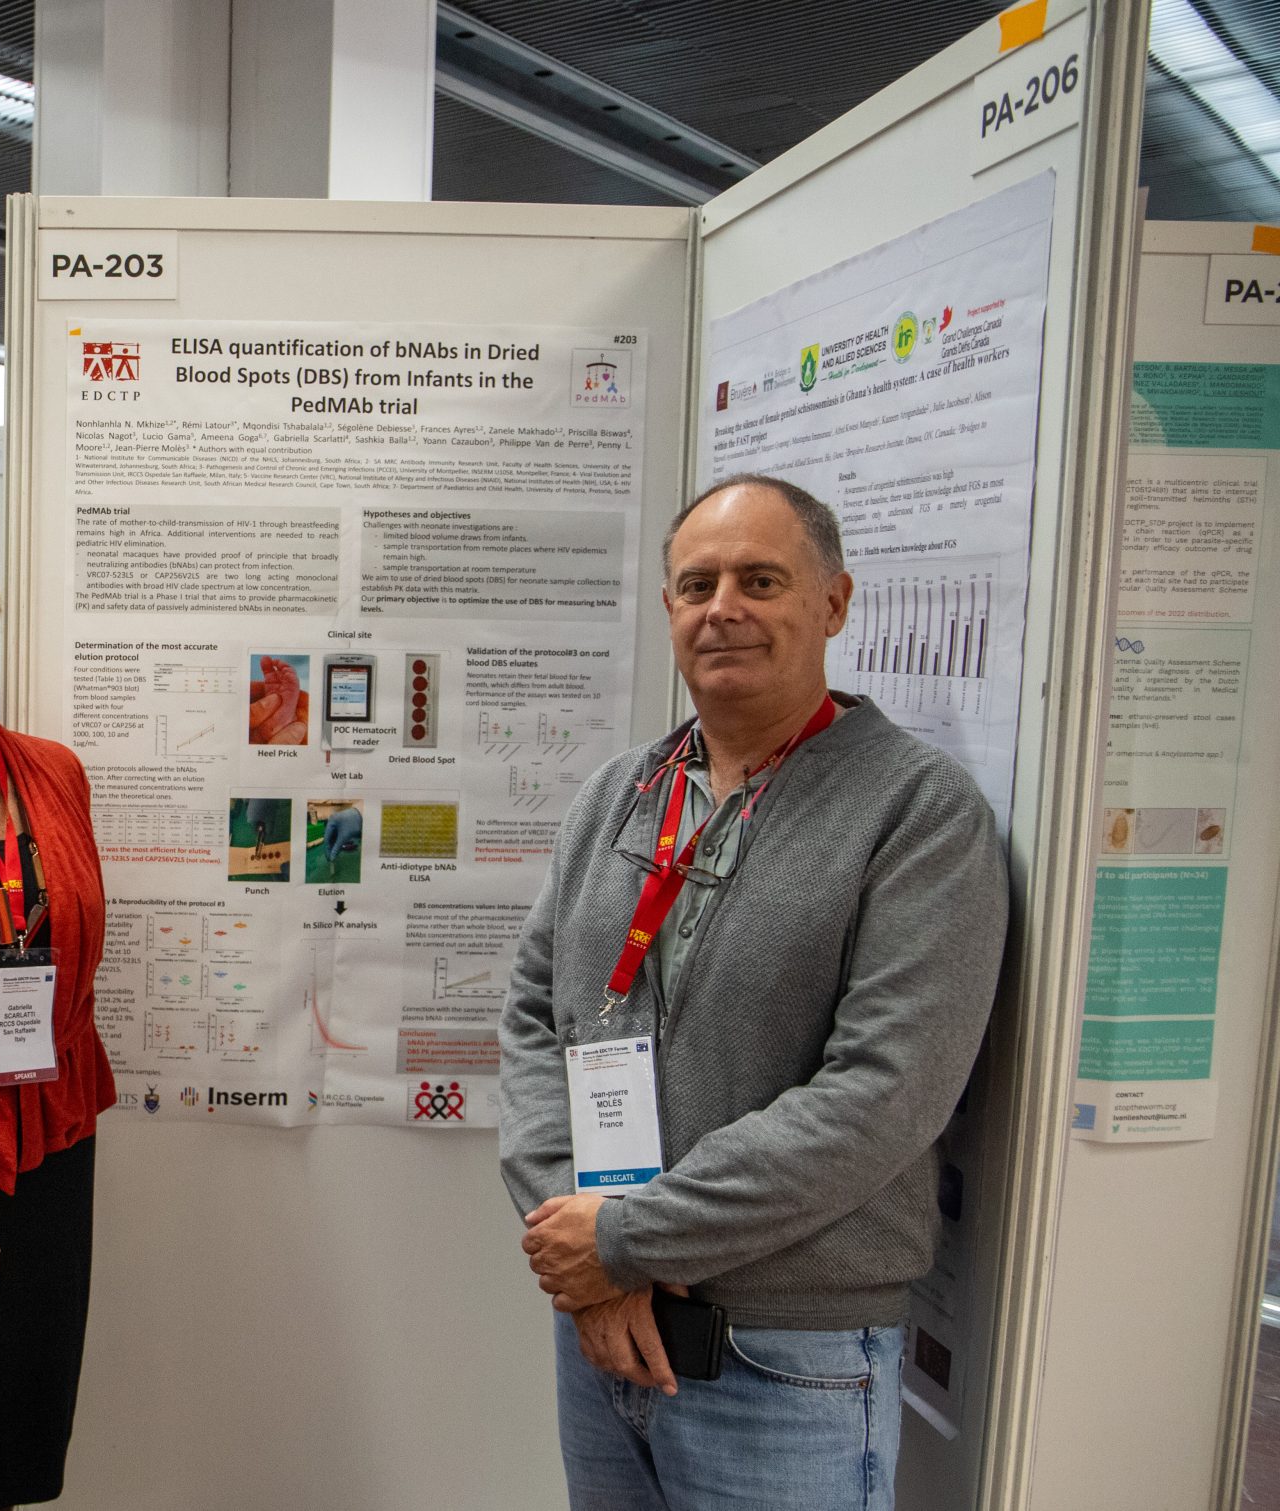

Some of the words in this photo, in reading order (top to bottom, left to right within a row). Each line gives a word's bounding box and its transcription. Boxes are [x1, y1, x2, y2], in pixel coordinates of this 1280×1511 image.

[981, 54, 1079, 138] PA-206
[52, 253, 163, 279] PA-203
[614, 336, 637, 344] #203
[822, 337, 853, 356] UNIVERSITY
[855, 333, 863, 345] OF
[865, 325, 888, 342] HEALTH
[172, 338, 222, 354] ELISA
[229, 337, 362, 360] quantification
[370, 340, 389, 357] of
[396, 341, 457, 358] bNAbs
[464, 344, 480, 358] in
[488, 343, 538, 360] Dried
[822, 357, 833, 369] AND
[835, 350, 854, 365] ALLIED
[856, 340, 885, 358] SCIENCES
[176, 365, 230, 382] Blood
[238, 367, 289, 387] Spots
[297, 367, 347, 388] (DBS)
[355, 368, 399, 385] from
[408, 369, 471, 387] Infants
[479, 372, 494, 387] in
[502, 372, 532, 388] the
[81, 391, 140, 400] EDCTP
[715, 423, 733, 439] Breaking
[743, 417, 757, 429] silence
[759, 415, 763, 425] of
[765, 410, 779, 423] female
[780, 405, 796, 421] genital
[798, 394, 838, 414] schistosomiasis
[840, 392, 844, 403] in
[846, 384, 871, 401] Ghana's
[872, 378, 891, 394] health
[893, 373, 916, 390] system:
[919, 370, 924, 381] A
[926, 367, 940, 379] case
[943, 362, 950, 374] of
[952, 355, 974, 372] health
[978, 346, 1009, 365] workers
[576, 394, 626, 403] PedMAb
[292, 396, 372, 413] PedMAb
[380, 398, 416, 414] trial
[838, 471, 856, 482] Results
[76, 506, 111, 514] PedMAb
[363, 510, 410, 518] Hypotheses
[430, 511, 470, 520] objectives
[109, 529, 124, 537] high
[327, 630, 355, 638] Clinical
[74, 641, 132, 649] Determination
[508, 647, 517, 655] of
[534, 648, 577, 657] protocol#3
[74, 652, 102, 660] elution
[105, 653, 138, 662] protocol
[466, 658, 489, 666] blood
[509, 659, 537, 667] eluates
[1144, 658, 1165, 666] Quality
[352, 726, 396, 734] Hematocrit
[353, 738, 380, 746] reader
[278, 749, 296, 757] Prick
[437, 756, 454, 764] Spot
[380, 862, 432, 871] Anti-idiotype
[409, 874, 431, 883] ELISA
[245, 886, 270, 896] Punch
[318, 887, 345, 897] Elution
[334, 920, 343, 928] PK
[346, 921, 376, 930] analysis
[4, 1012, 36, 1020] SCARLATTI
[16, 1019, 41, 1027] Ospedale
[14, 1072, 36, 1080] SPEAKER
[208, 1087, 288, 1108] Inserm
[590, 1089, 628, 1100] Jean-pierre
[596, 1099, 622, 1108] MOLÈS
[598, 1110, 622, 1118] Inserm
[600, 1120, 624, 1128] France
[600, 1174, 634, 1183] DELEGATE
